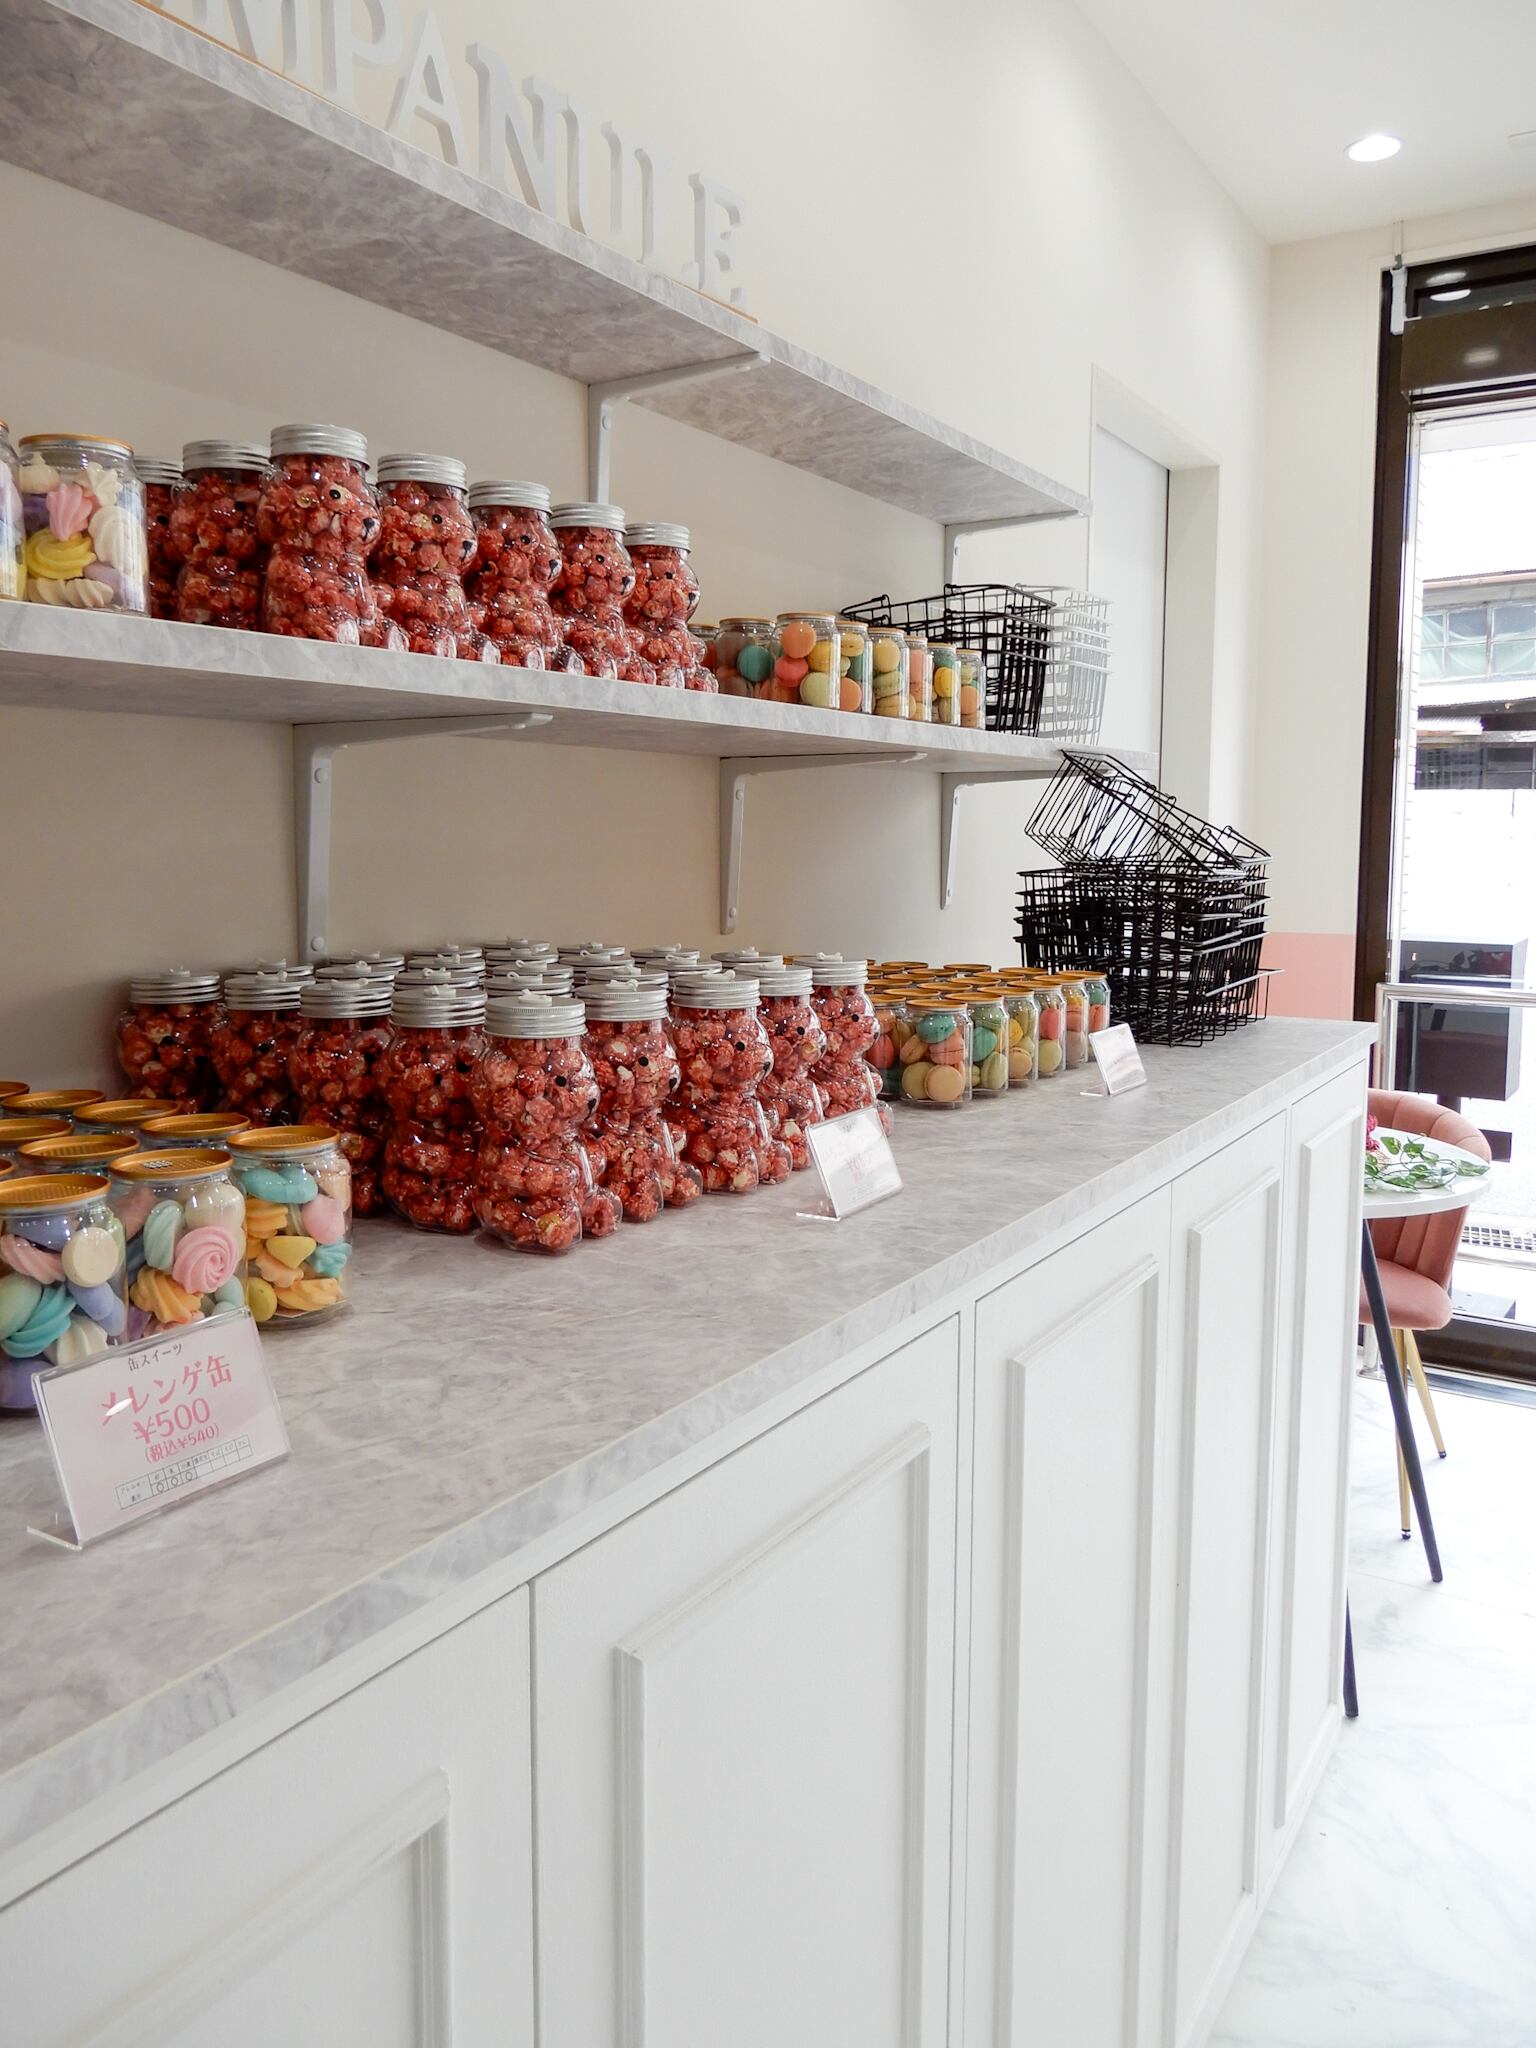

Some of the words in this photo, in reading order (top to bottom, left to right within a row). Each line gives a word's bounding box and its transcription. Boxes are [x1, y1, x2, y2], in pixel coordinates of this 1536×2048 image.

[128, 1343, 182, 1371] 缶スイーツ
[101, 1355, 232, 1426] メレンゲ缶
[132, 1397, 210, 1443] ¥500
